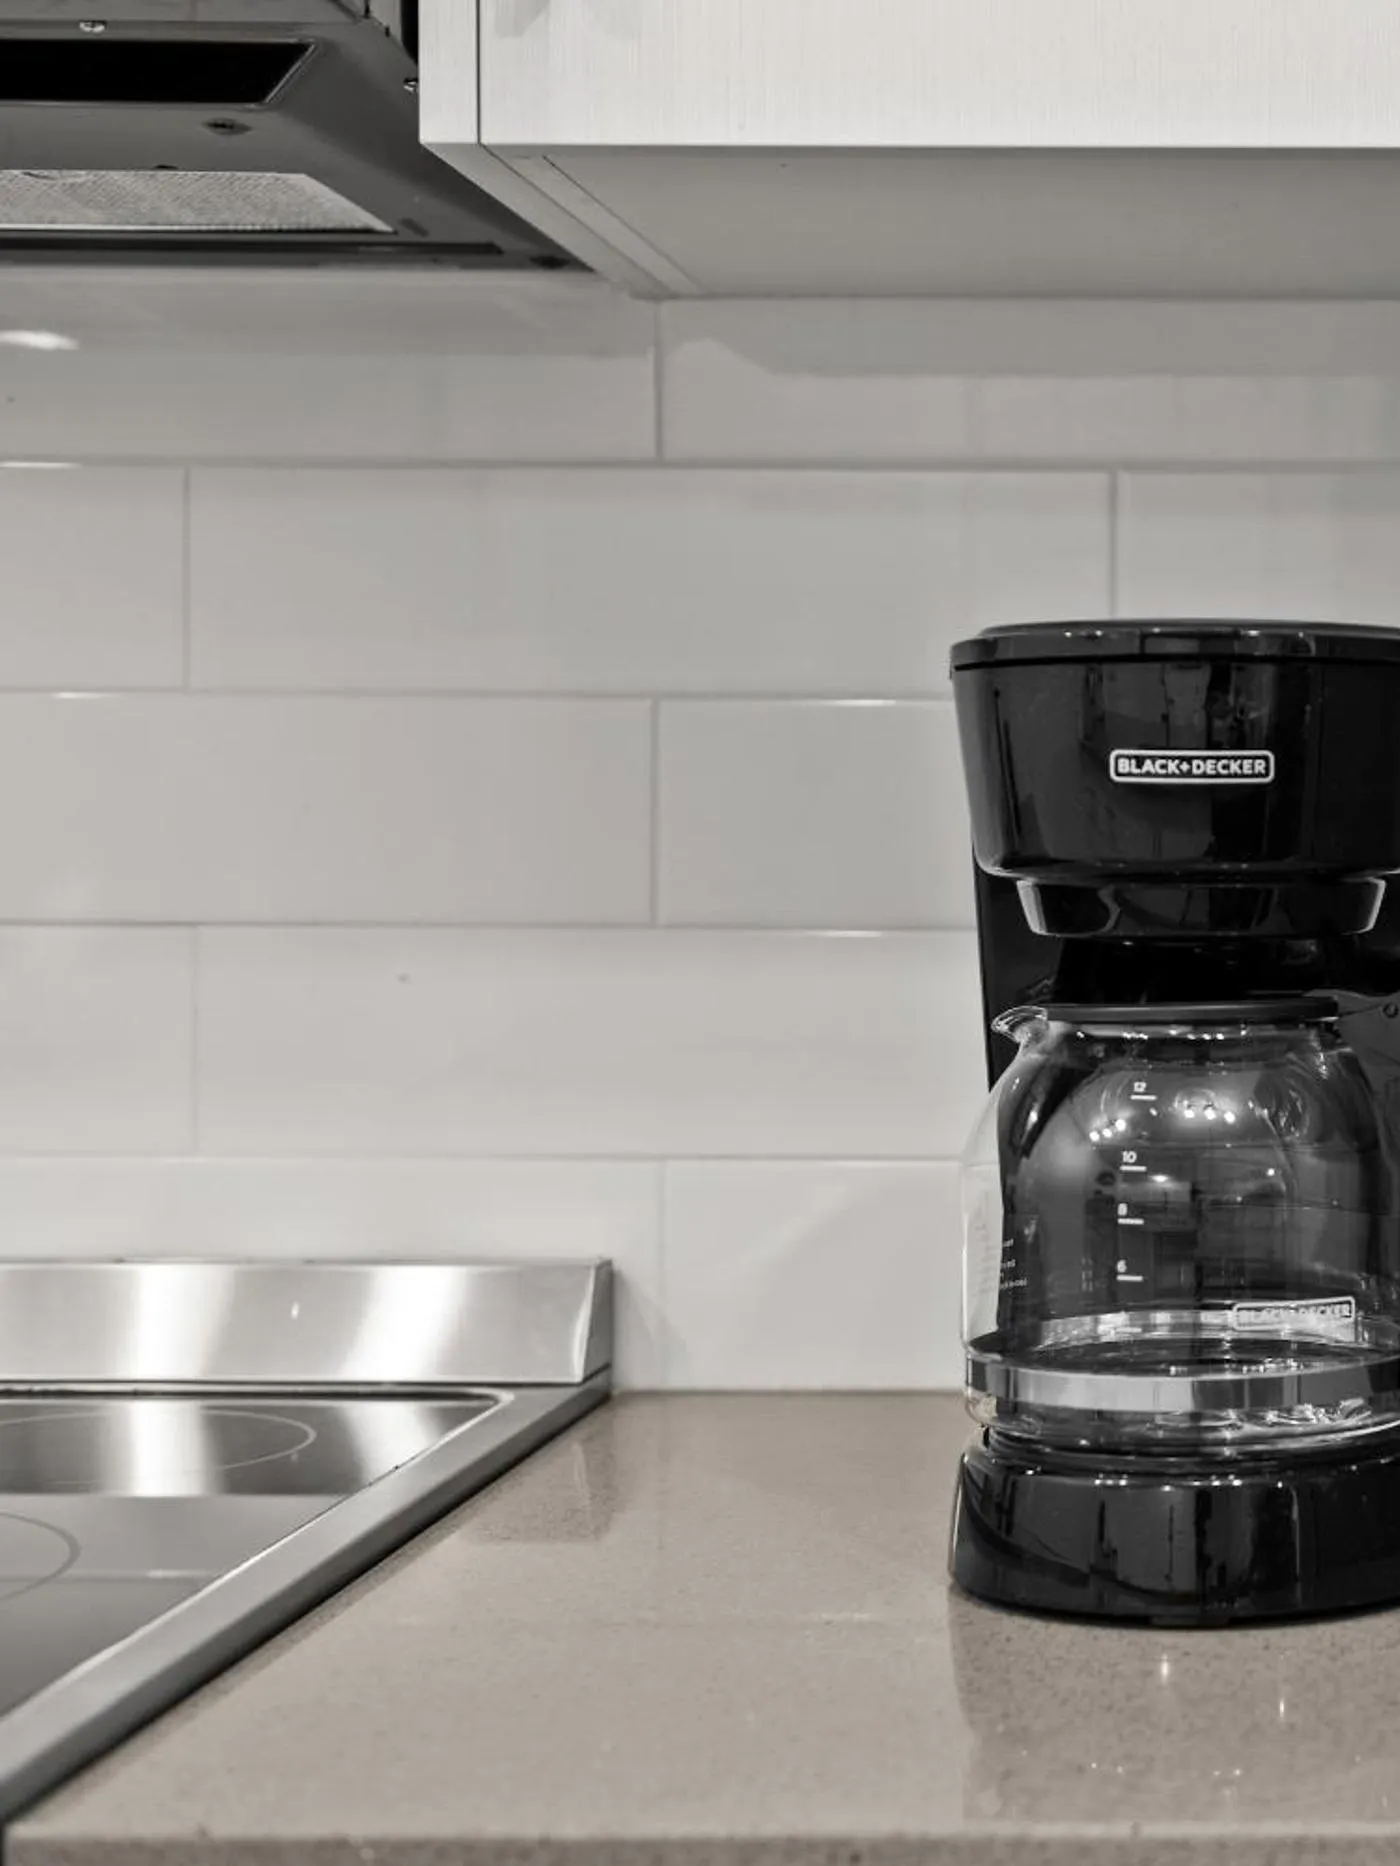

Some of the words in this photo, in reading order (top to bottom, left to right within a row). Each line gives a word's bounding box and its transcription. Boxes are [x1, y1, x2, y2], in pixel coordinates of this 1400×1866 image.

[1116, 757, 1267, 775] BLACK+DECKER
[1122, 1150, 1137, 1163] 10
[1116, 1259, 1127, 1273] 6
